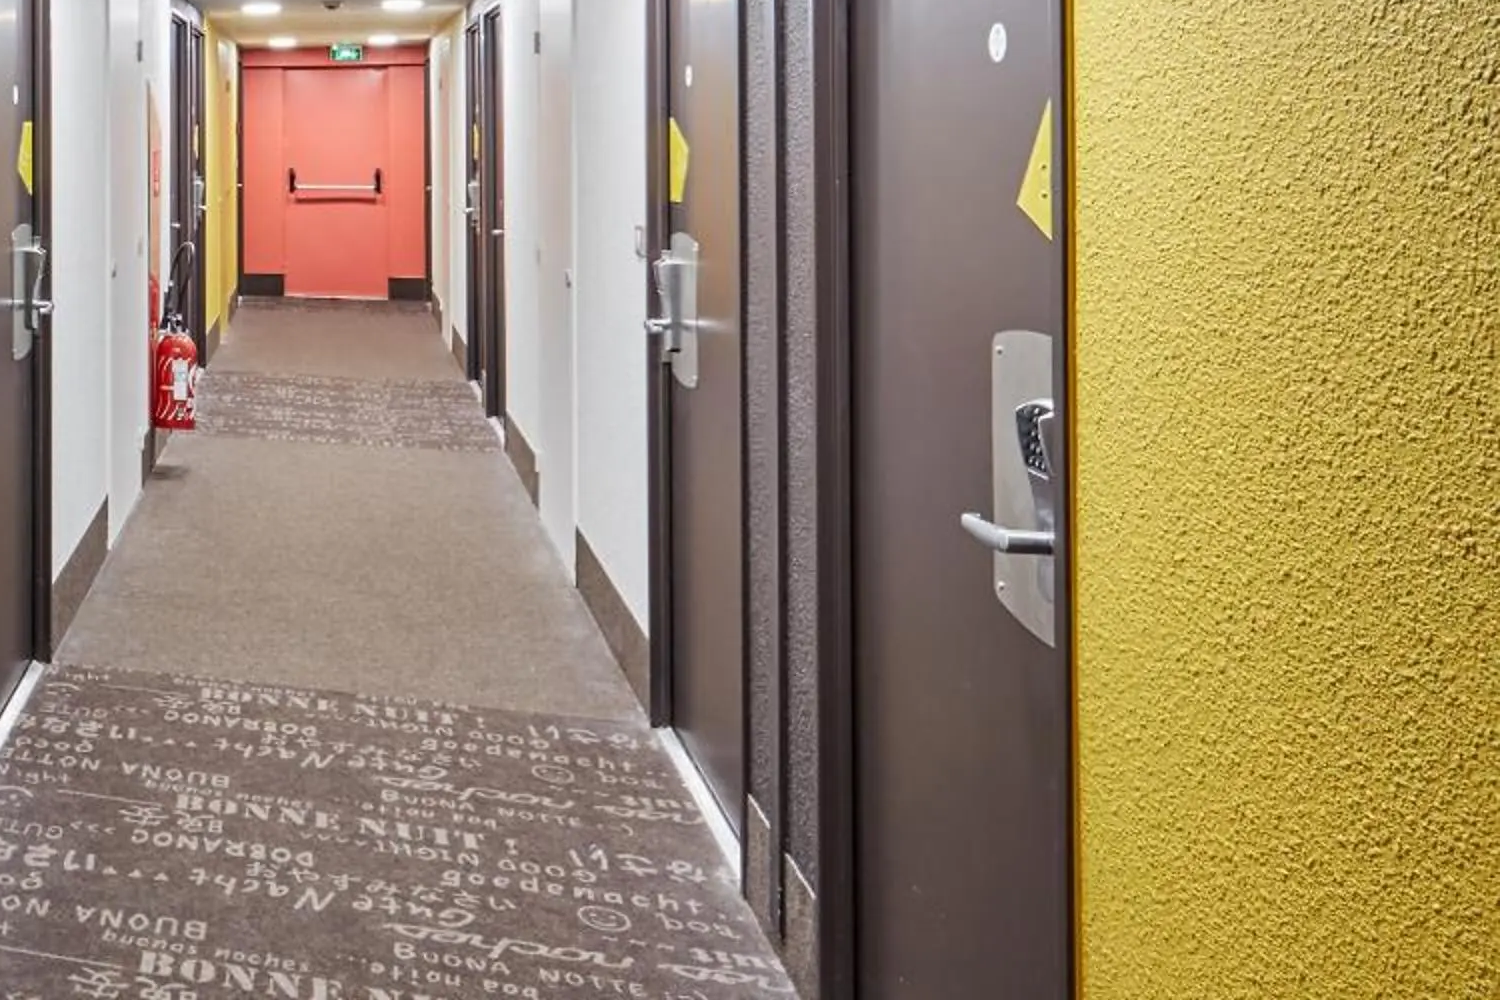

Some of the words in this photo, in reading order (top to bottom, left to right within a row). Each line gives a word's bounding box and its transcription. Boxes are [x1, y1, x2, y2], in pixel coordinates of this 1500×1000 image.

[119, 761, 230, 789] BUONA
[175, 792, 340, 831] BONNE
[356, 816, 487, 851] NUIT
[130, 827, 314, 868] DOBRANOC
[183, 865, 335, 917] Nacht
[351, 892, 478, 932] Gute
[72, 904, 207, 941] BUONA
[138, 949, 342, 1000] BONNE
[392, 940, 510, 976] BUONA
[538, 966, 649, 999] NOTTE
